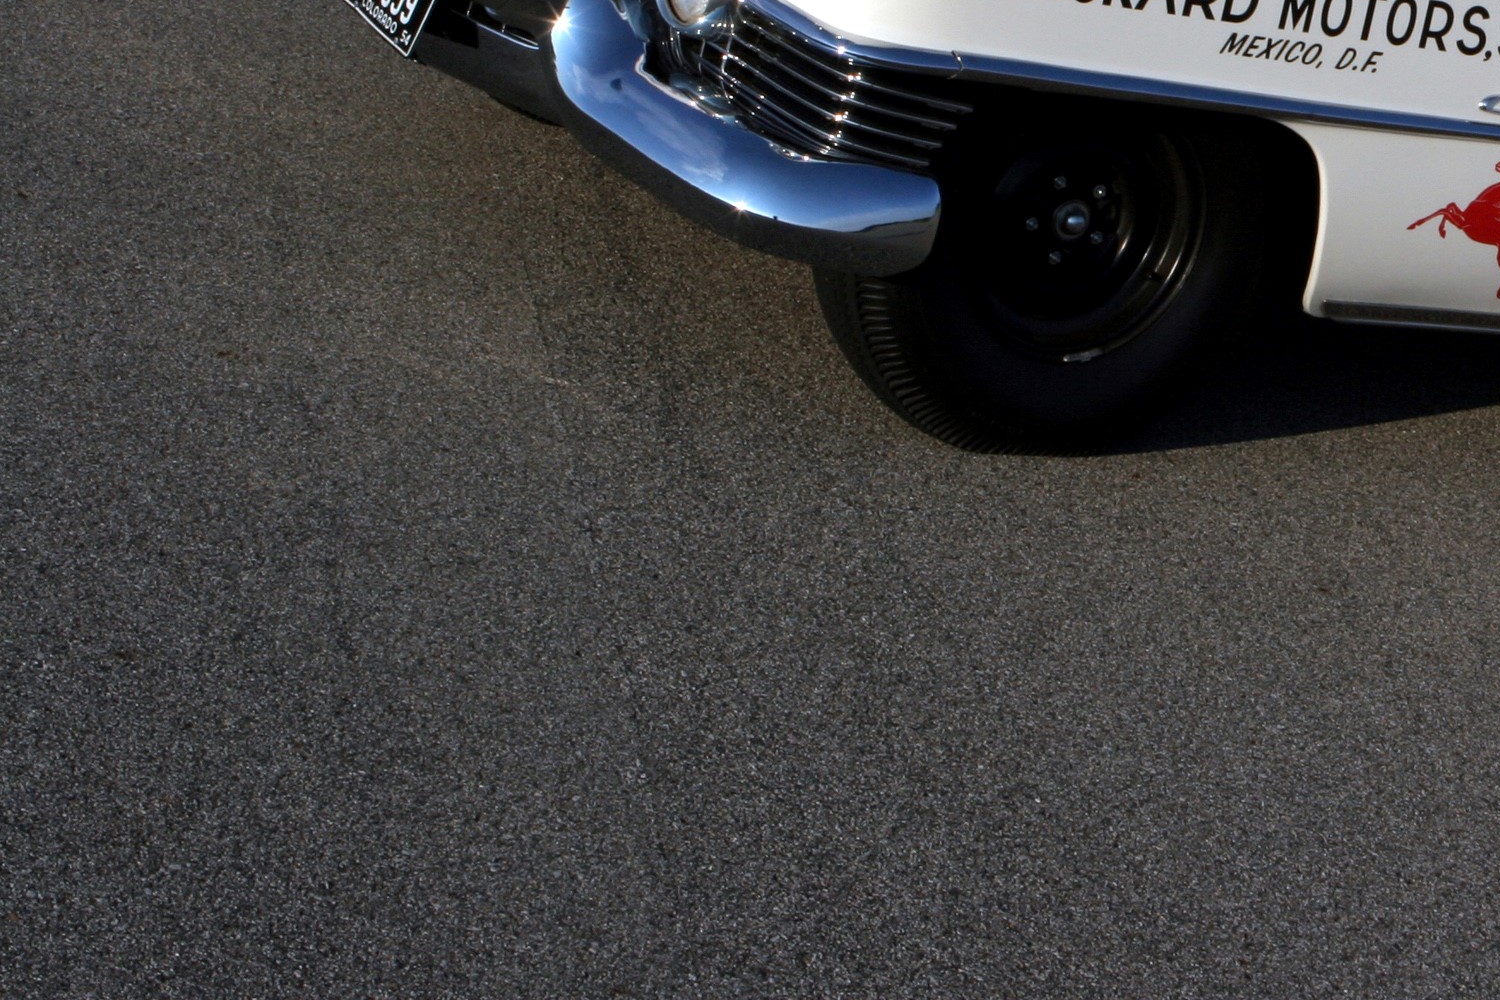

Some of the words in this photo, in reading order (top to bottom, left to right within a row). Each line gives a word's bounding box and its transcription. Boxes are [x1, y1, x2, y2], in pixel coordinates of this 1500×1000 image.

[400, 30, 412, 46] 54
[1219, 32, 1323, 70] MEXICO,
[1335, 47, 1384, 73] D.F.
